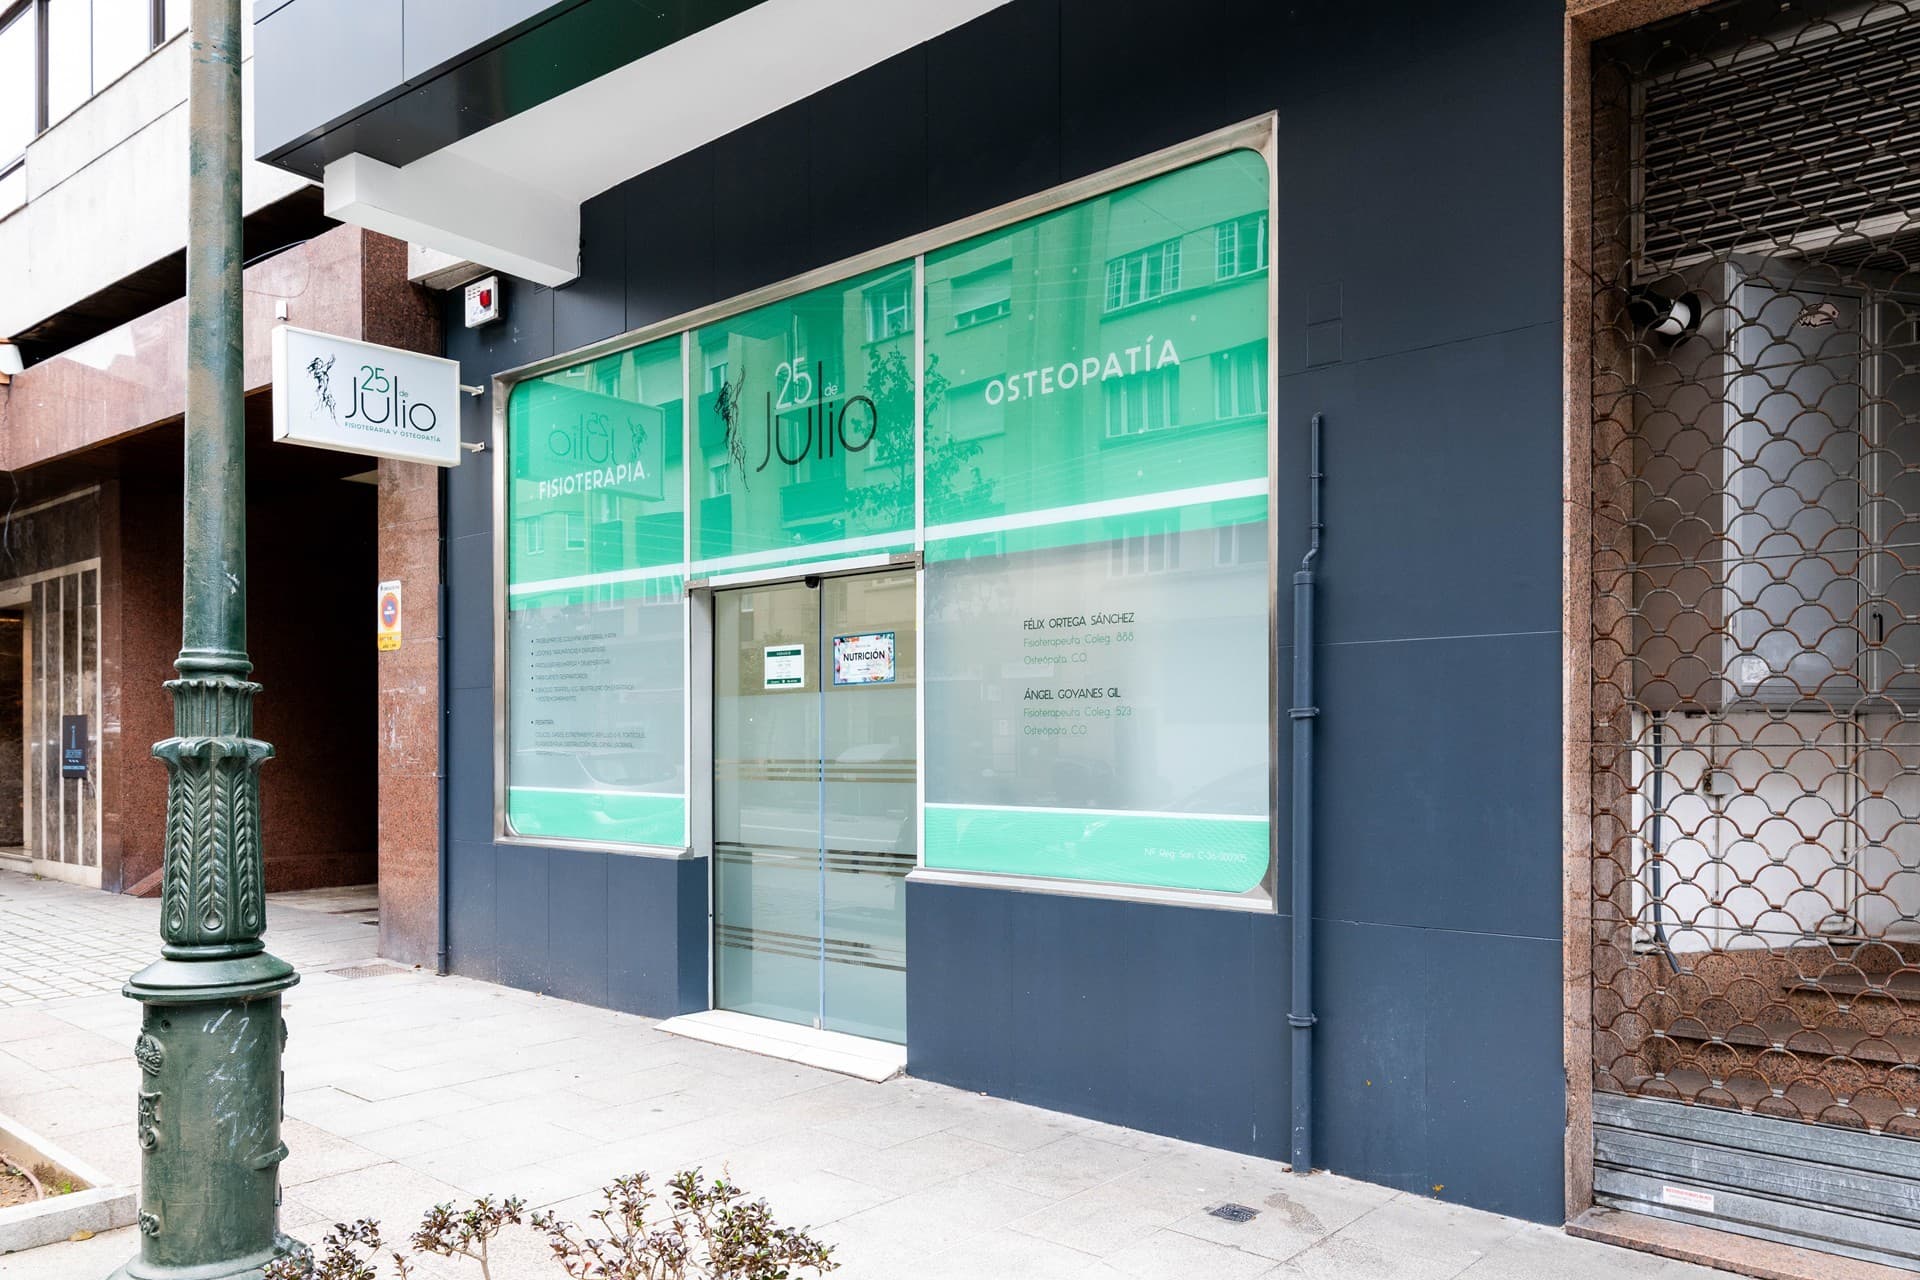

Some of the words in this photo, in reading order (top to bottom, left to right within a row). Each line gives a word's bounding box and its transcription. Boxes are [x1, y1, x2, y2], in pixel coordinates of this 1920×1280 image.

[985, 335, 1179, 406] OSTEOPATÍA
[360, 365, 390, 394] 25
[399, 390, 409, 398] de
[775, 357, 813, 409] 25
[824, 382, 838, 397] de
[345, 421, 391, 434] FISIOTERAPIA
[400, 431, 441, 443] OSTEOPATÍA
[539, 461, 647, 500] FISIOTERAPIA
[1023, 617, 1045, 630] FÉLIX
[1048, 615, 1087, 629] ORTEGA
[1090, 612, 1135, 626] SÁNCHEZ
[1023, 635, 1081, 648] Fisioterapeuta
[1116, 631, 1135, 642] 888
[843, 648, 885, 662] NUTRICIÓN
[1023, 687, 1054, 700] ÁNGEL
[1057, 687, 1103, 698] GOYANES
[1107, 687, 1121, 698] GIL
[1023, 707, 1081, 719] Fisioterapeuta
[1115, 705, 1132, 716] 523
